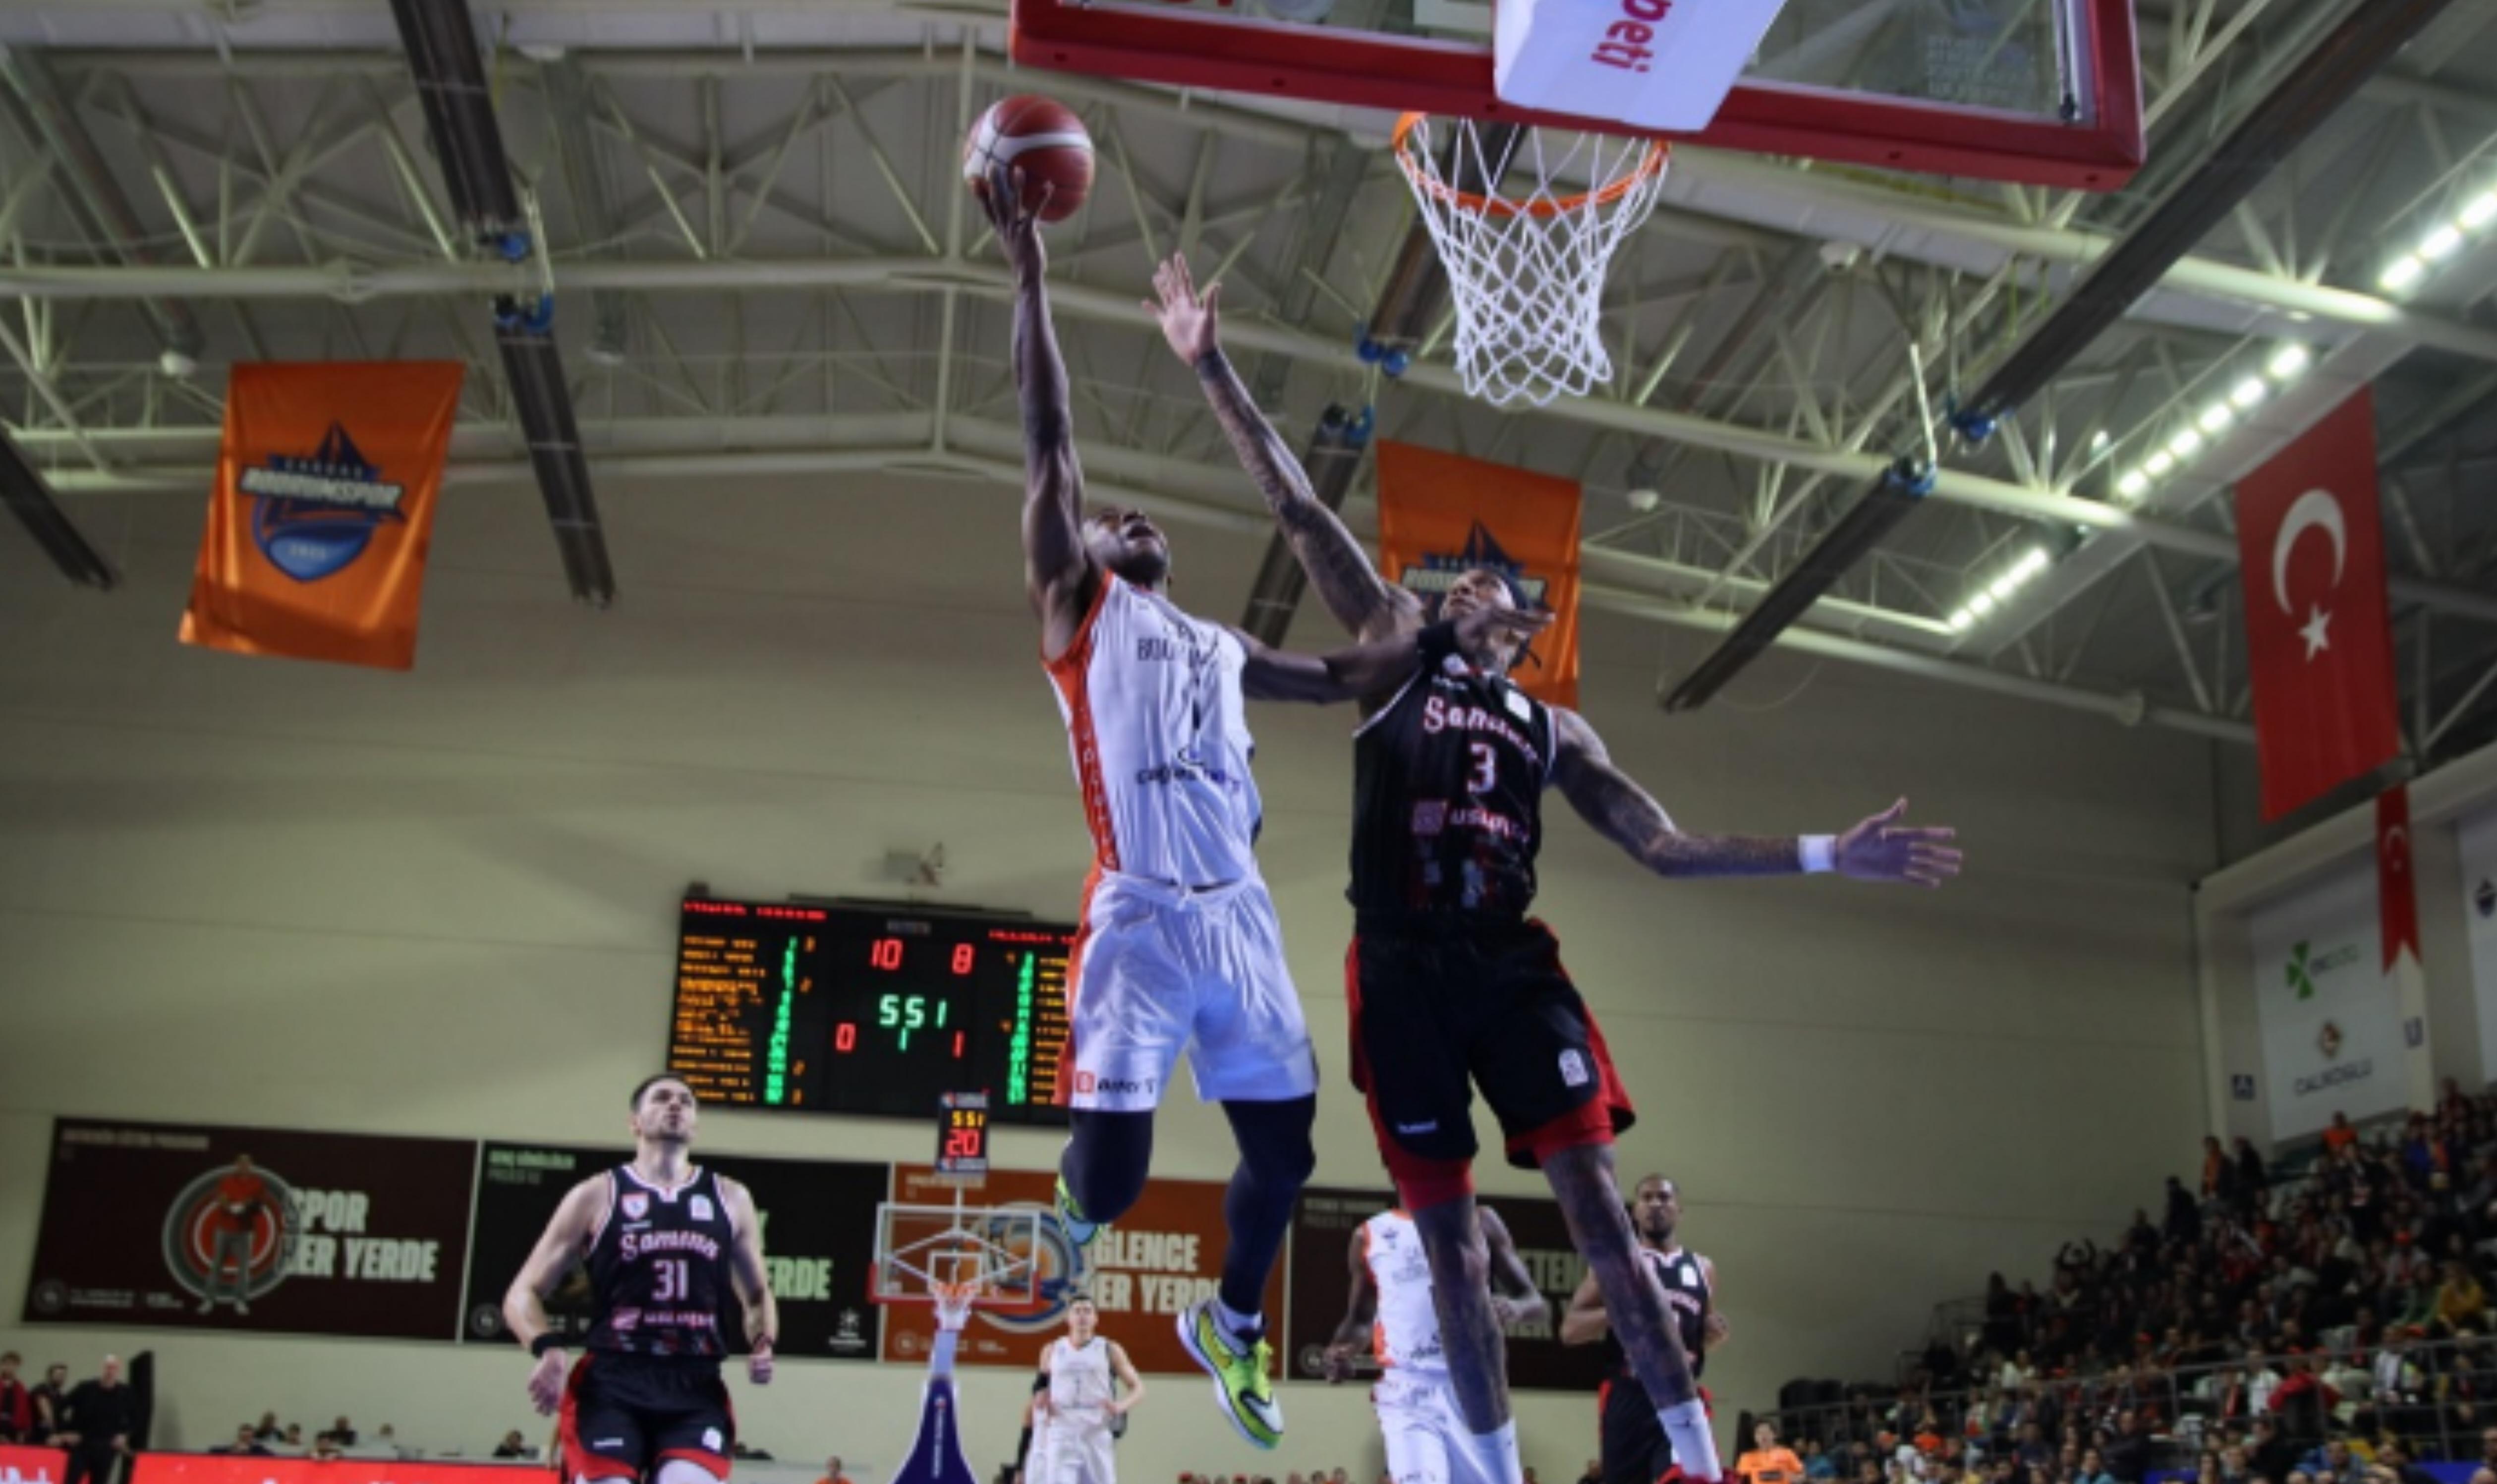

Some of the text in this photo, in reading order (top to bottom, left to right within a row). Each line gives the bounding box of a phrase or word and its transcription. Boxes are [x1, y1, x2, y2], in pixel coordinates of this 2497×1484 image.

[1466, 742, 1496, 794] 3
[871, 938, 904, 970] 10
[952, 943, 974, 974] 8
[836, 1022, 856, 1051] 0
[898, 1026, 908, 1051] 1
[953, 1030, 965, 1058] 1
[946, 1128, 980, 1156] 20
[285, 1234, 439, 1283] ER YERDE
[651, 1258, 688, 1301] 31
[1086, 1272, 1221, 1313] ER YERD
